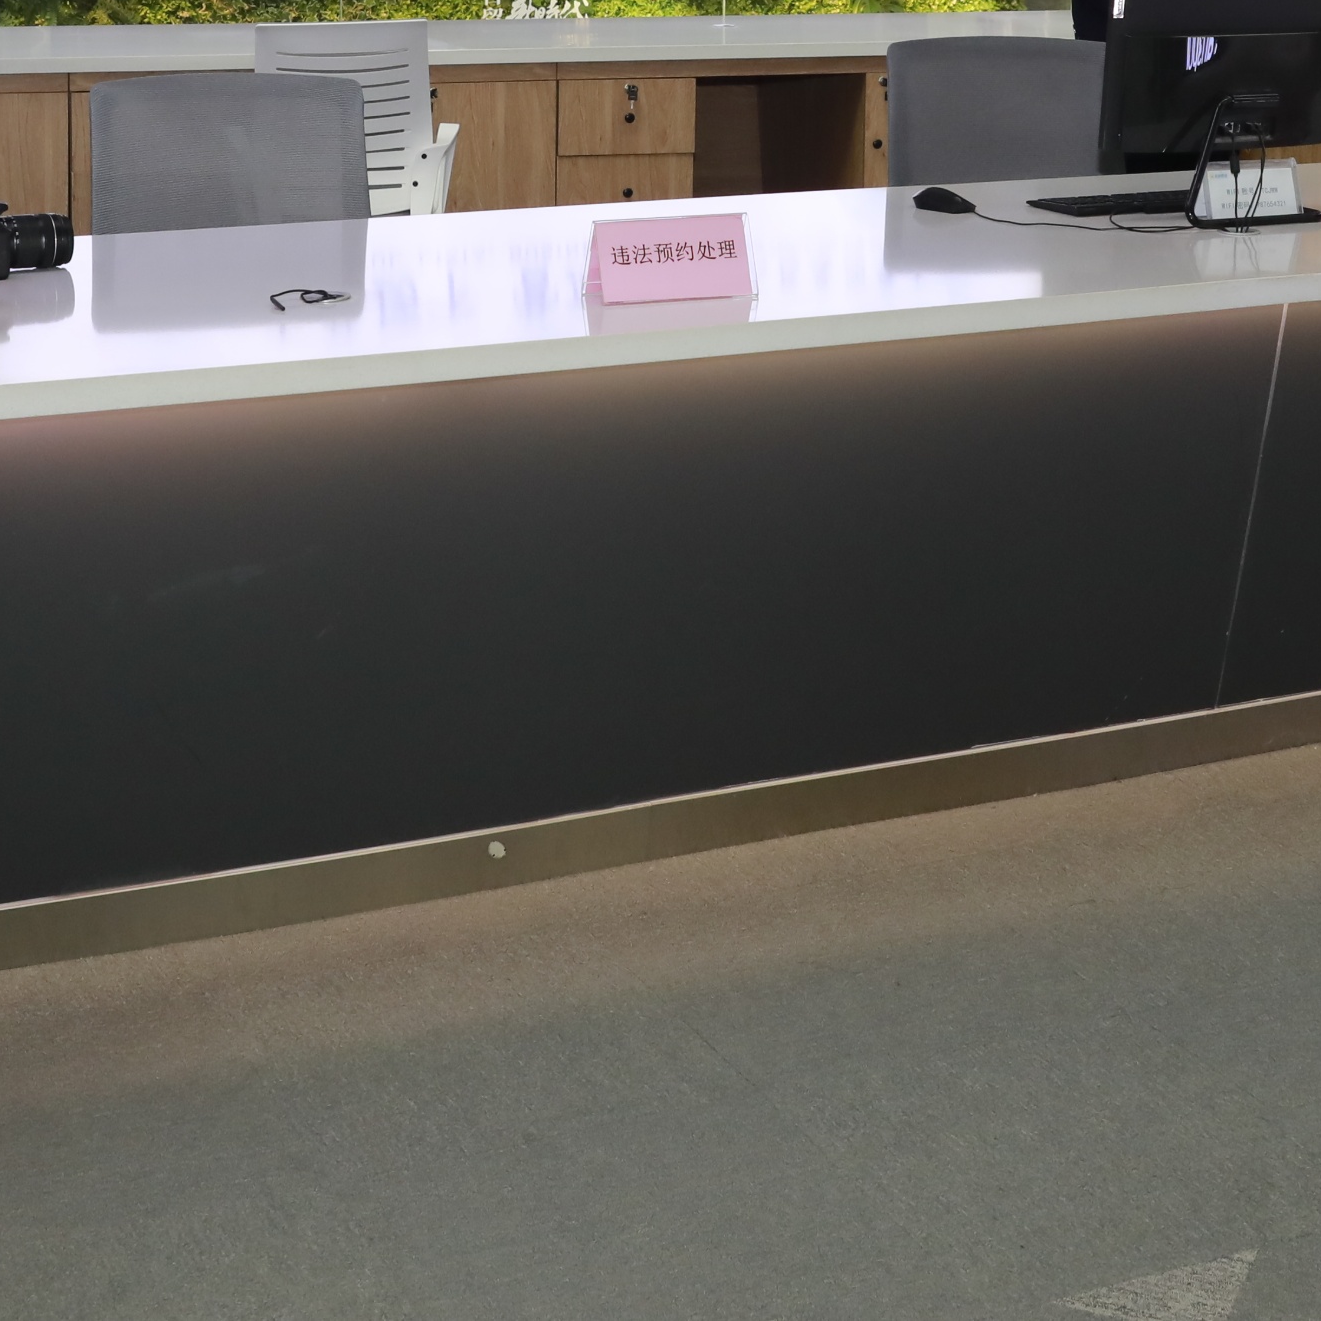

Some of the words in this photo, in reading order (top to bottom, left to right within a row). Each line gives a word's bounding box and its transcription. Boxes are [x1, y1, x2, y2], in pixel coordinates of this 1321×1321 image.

[610, 239, 738, 266] 违法预约处理
